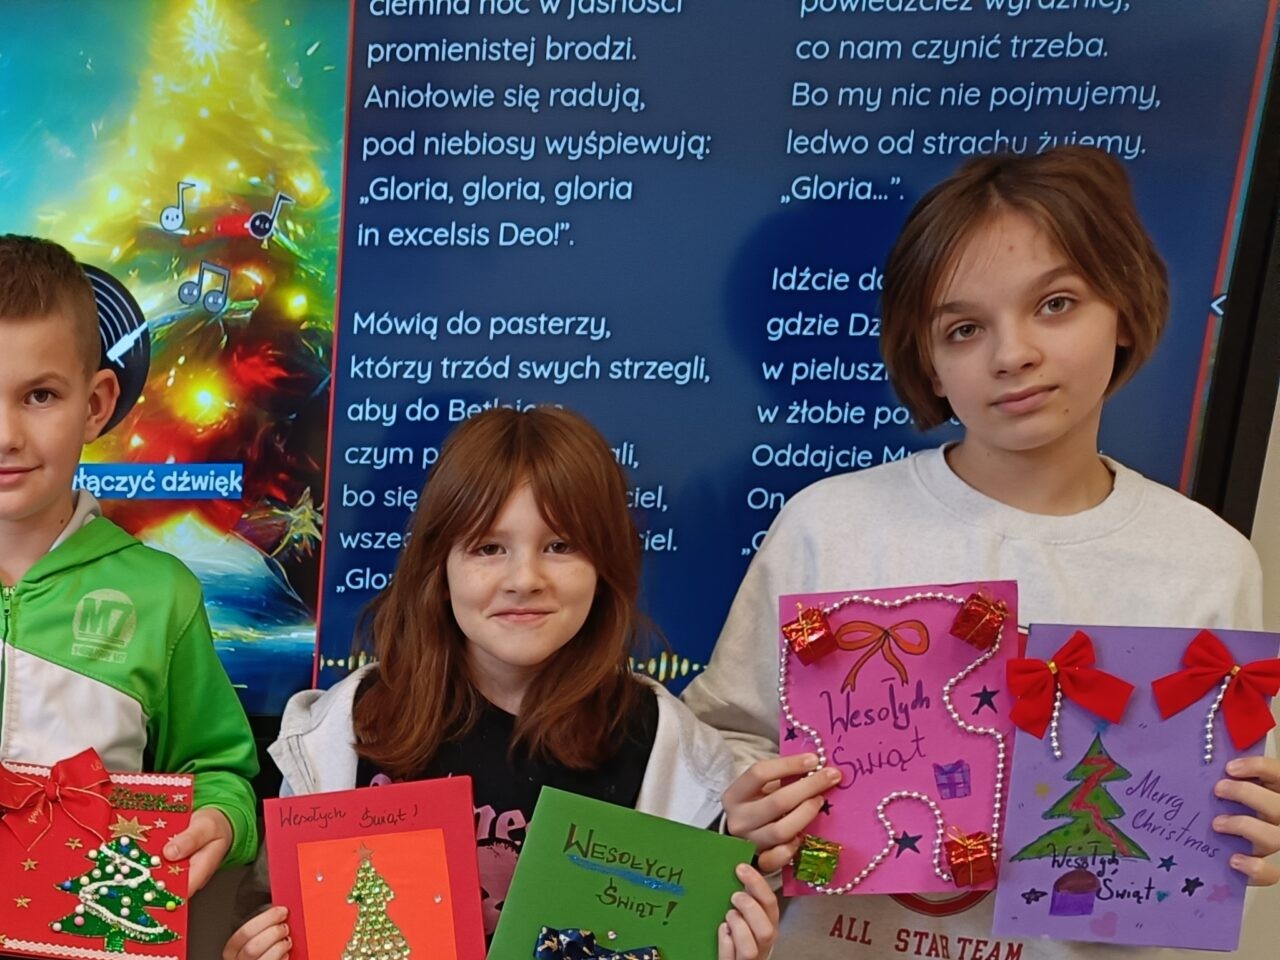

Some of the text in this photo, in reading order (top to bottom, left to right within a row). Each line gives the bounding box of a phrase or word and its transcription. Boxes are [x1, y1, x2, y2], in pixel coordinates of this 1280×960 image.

[367, 34, 637, 69] promienistej brodzi.
[795, 31, 1108, 65] co nam czynić trzeba.
[364, 81, 645, 113] Aniołowie się radują,
[791, 80, 1161, 112] Bo my nic nie pojmujemy,
[362, 130, 712, 162] pod niebiosy wyśpiewują:
[786, 128, 869, 154] ledwo
[877, 129, 915, 155] od
[922, 129, 1028, 156] strachu
[359, 174, 633, 206] „Gloria, gloria, gloria
[357, 223, 379, 247] in
[388, 221, 490, 246] excelsis
[772, 265, 850, 291] Idźcie
[353, 310, 611, 341] Mówią do pasterzy,
[766, 310, 840, 342] gdzie
[350, 354, 710, 385] którzy trzód swych strzegli,
[762, 362, 784, 380] w
[347, 397, 397, 427] aby
[405, 397, 440, 421] do
[757, 405, 779, 423] w
[786, 399, 866, 424] żłobie
[344, 446, 414, 470] czym
[751, 443, 874, 473] Oddajcie
[161, 466, 243, 497] dźwięk
[342, 483, 419, 512] bo się
[832, 725, 926, 790] Świąt
[1125, 769, 1185, 821] Merry
[1131, 808, 1221, 859] Christmas
[562, 822, 684, 885] WESOŁYCH
[829, 914, 872, 946] ALL
[894, 927, 951, 960] STAR
